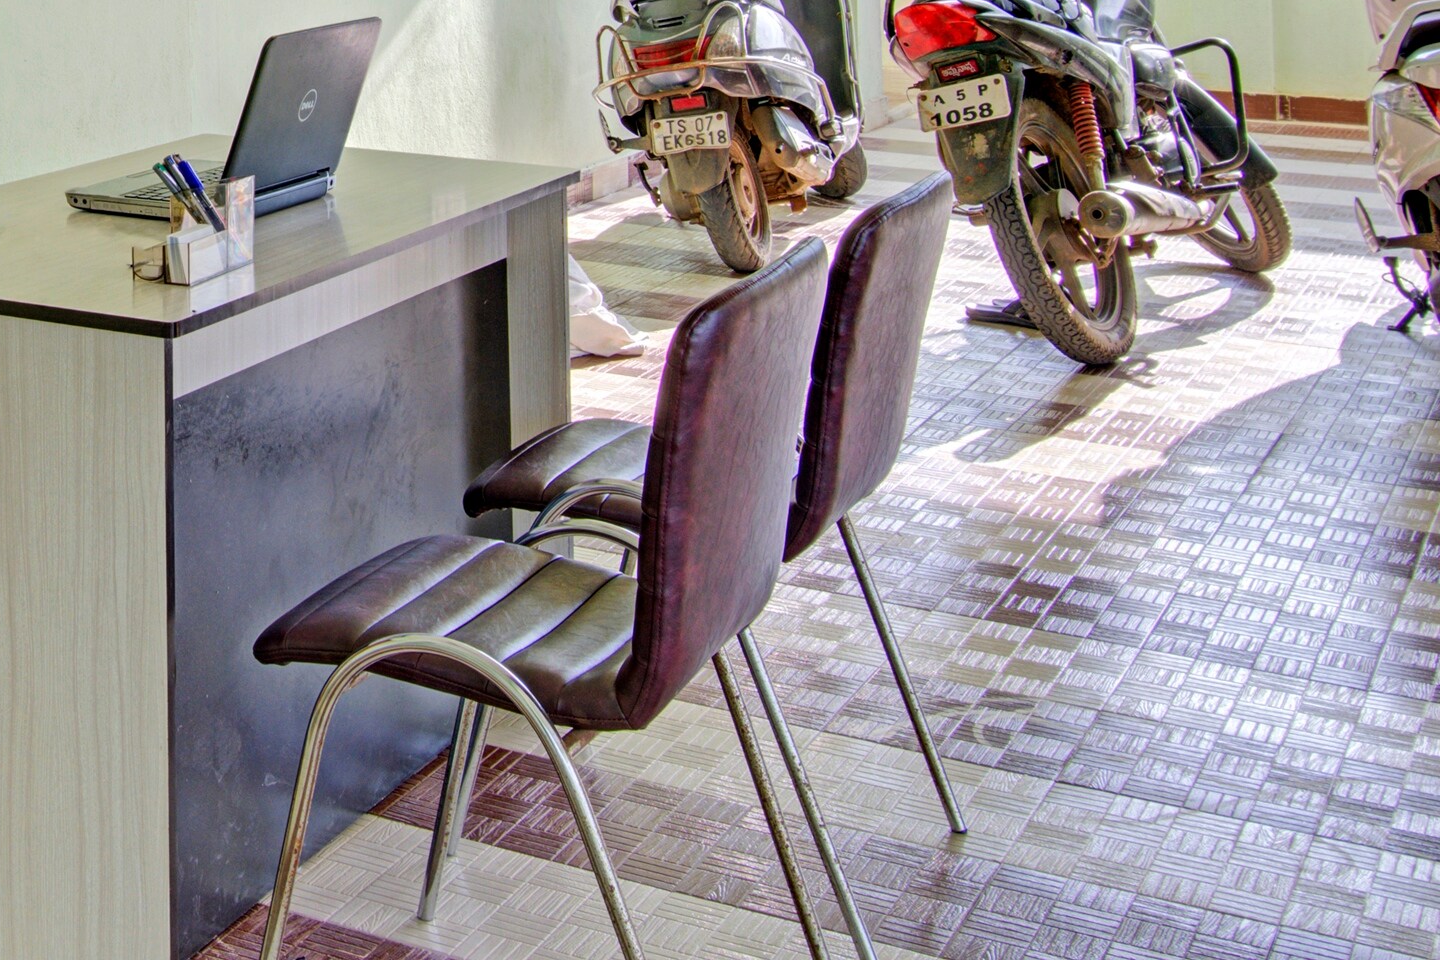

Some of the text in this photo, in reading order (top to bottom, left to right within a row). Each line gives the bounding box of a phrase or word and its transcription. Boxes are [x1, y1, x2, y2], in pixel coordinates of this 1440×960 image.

[667, 115, 713, 134] TS 07
[931, 102, 993, 126] 1058
[663, 130, 727, 151] EK6518
